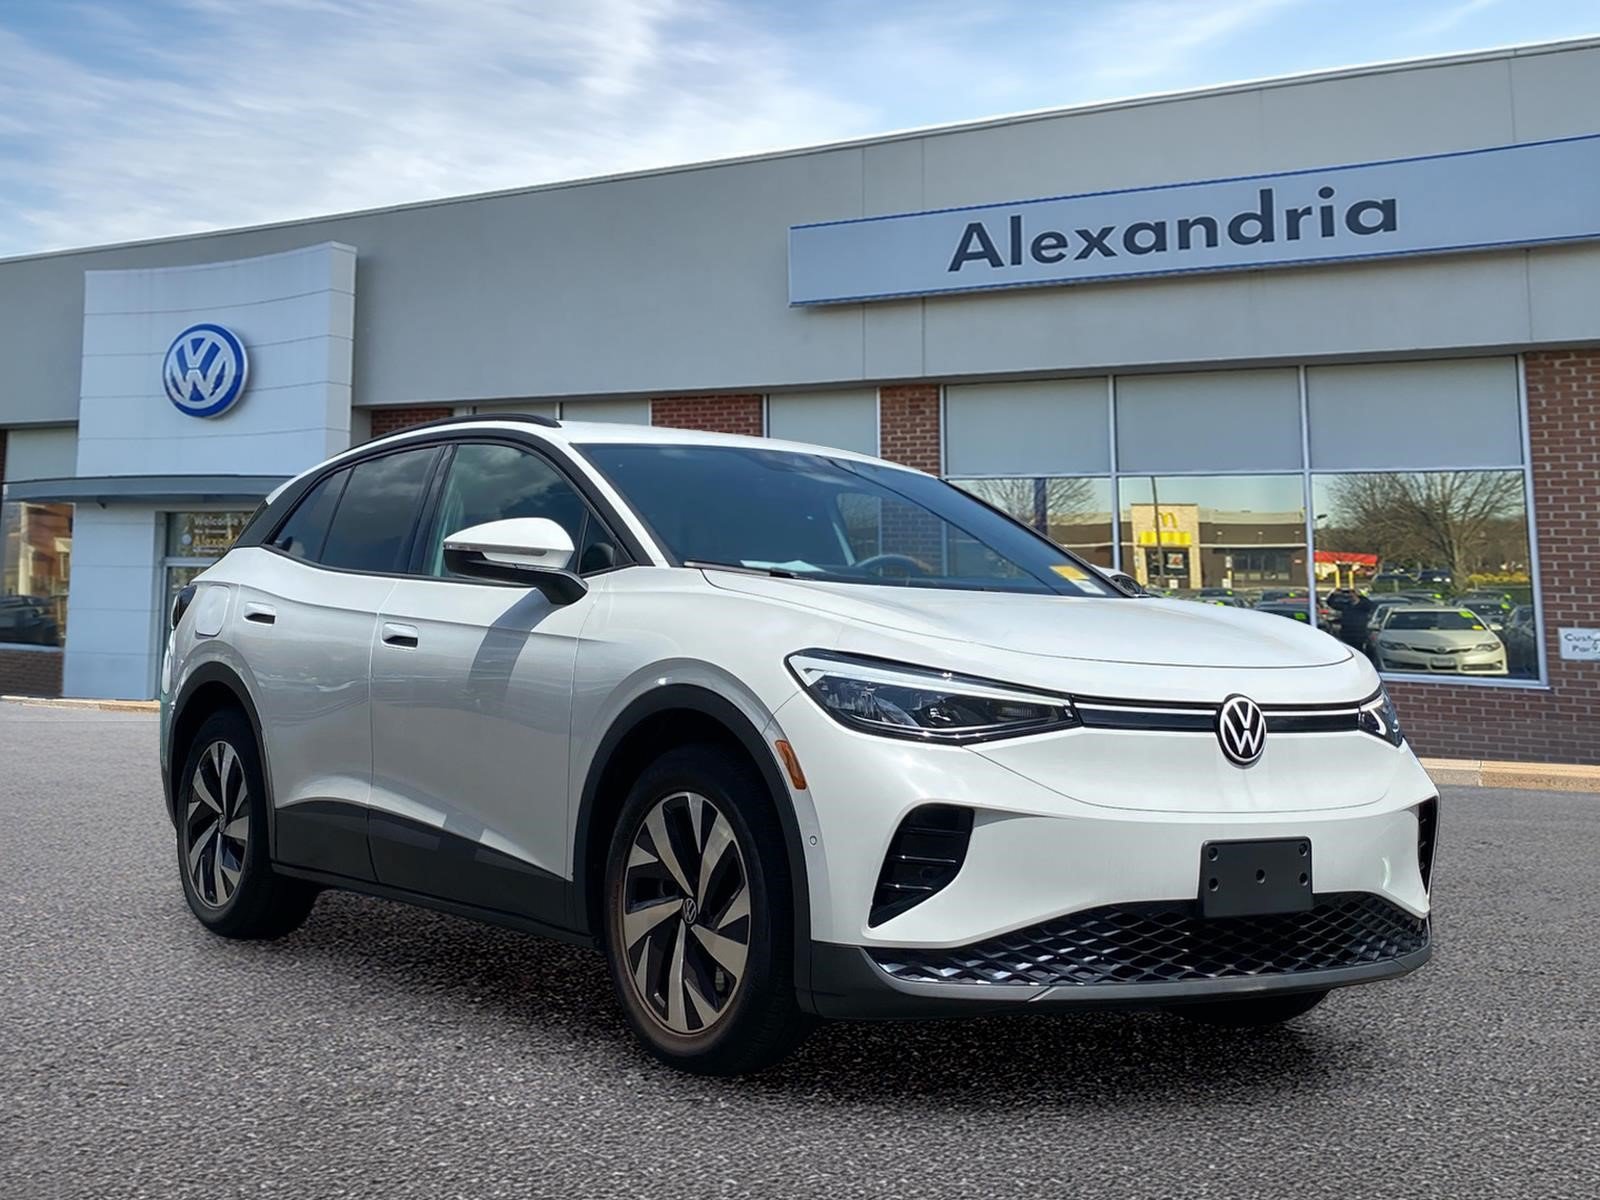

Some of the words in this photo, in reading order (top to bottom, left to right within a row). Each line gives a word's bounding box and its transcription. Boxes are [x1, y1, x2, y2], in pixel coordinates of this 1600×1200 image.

[948, 186, 1397, 272] Alexandria
[168, 328, 238, 410] VW
[1220, 697, 1266, 761] VW
